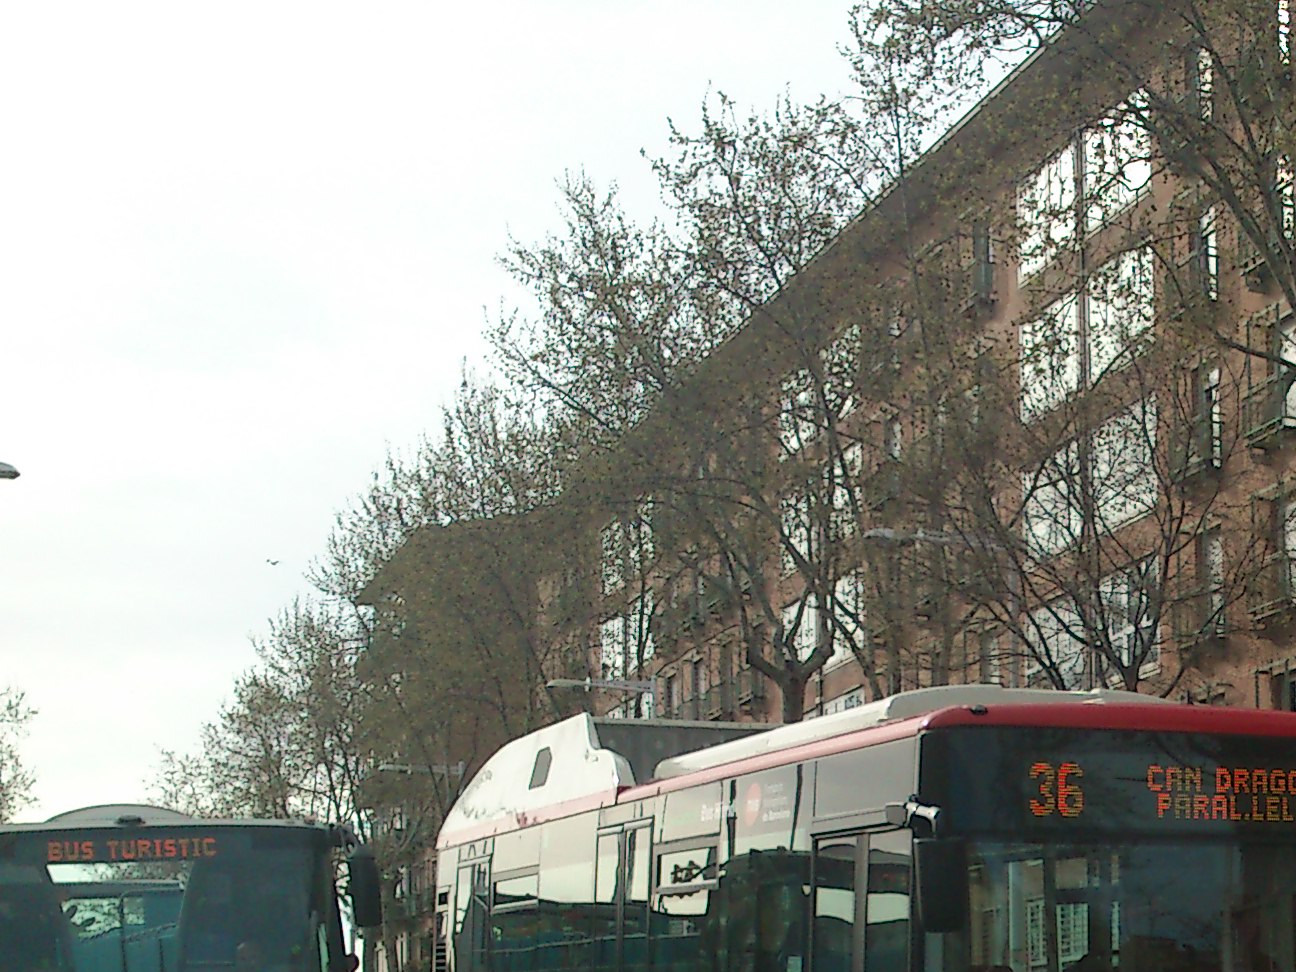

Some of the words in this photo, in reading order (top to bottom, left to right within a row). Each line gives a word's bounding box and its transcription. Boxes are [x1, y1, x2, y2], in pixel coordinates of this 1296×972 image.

[1028, 761, 1085, 818] 36
[1147, 764, 1202, 792] CAN
[47, 840, 94, 862] BUS
[106, 836, 217, 860] TURISTIC
